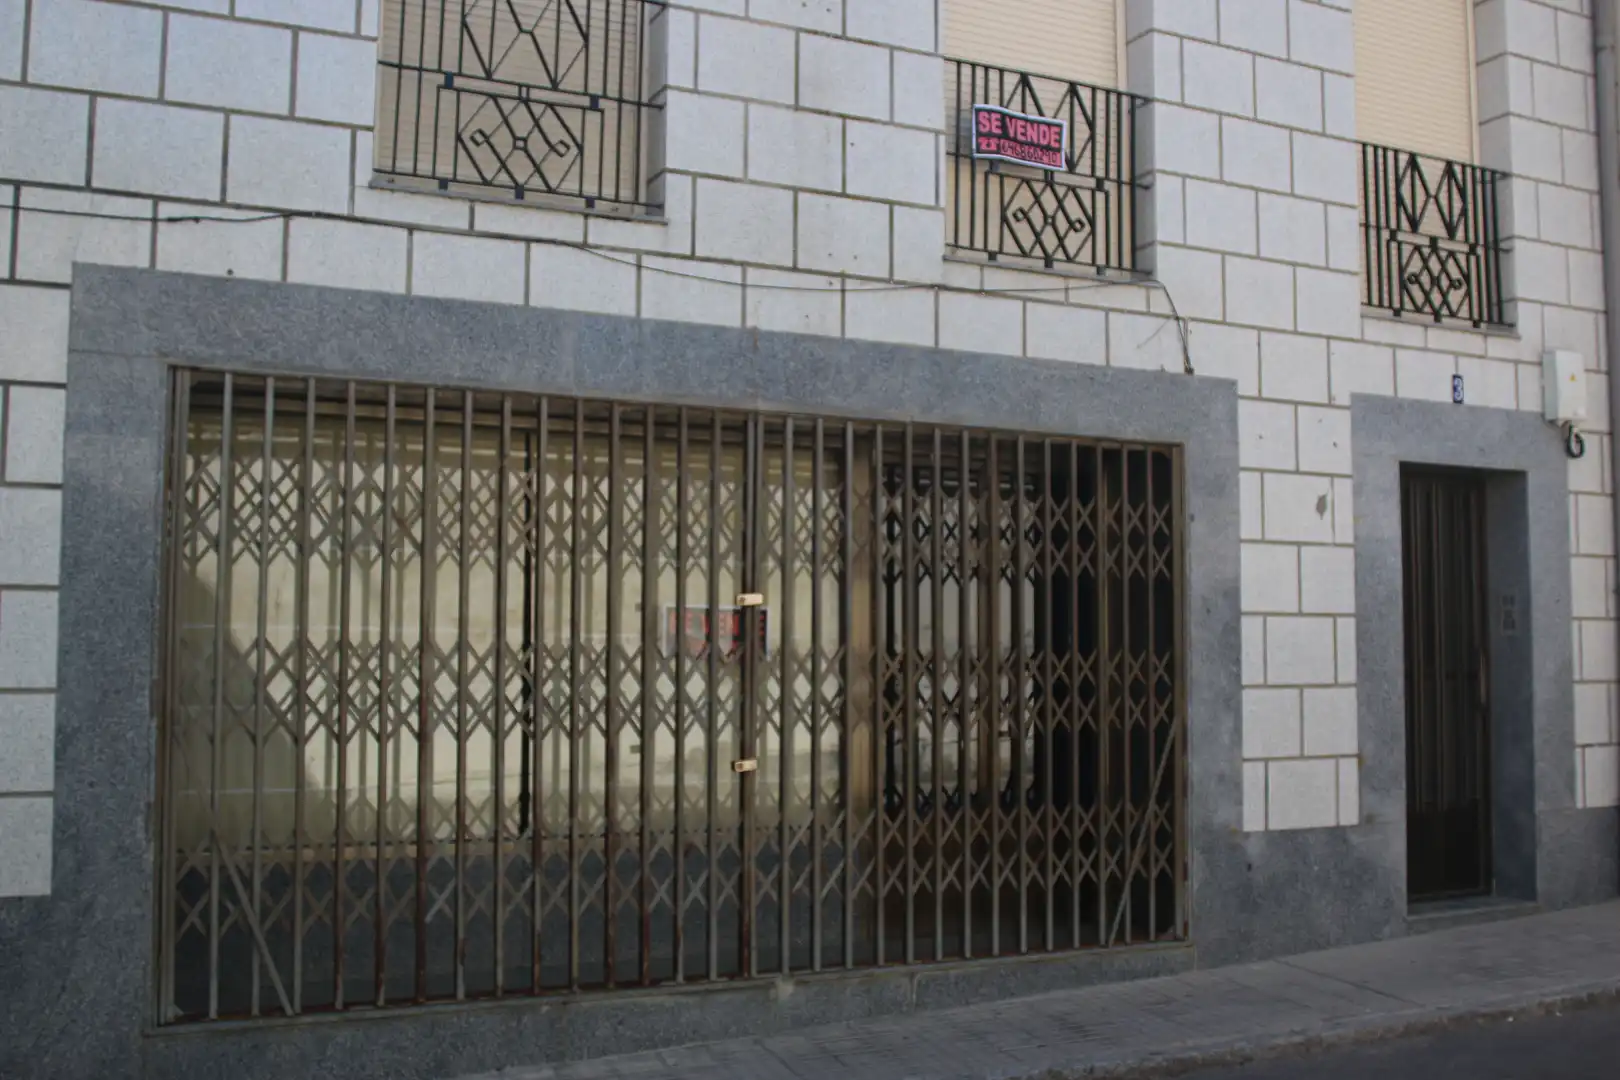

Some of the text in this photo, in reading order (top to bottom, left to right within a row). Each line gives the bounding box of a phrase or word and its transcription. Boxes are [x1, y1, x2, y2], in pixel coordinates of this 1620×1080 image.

[978, 111, 1061, 148] SE VENDE
[1453, 376, 1464, 402] 3
